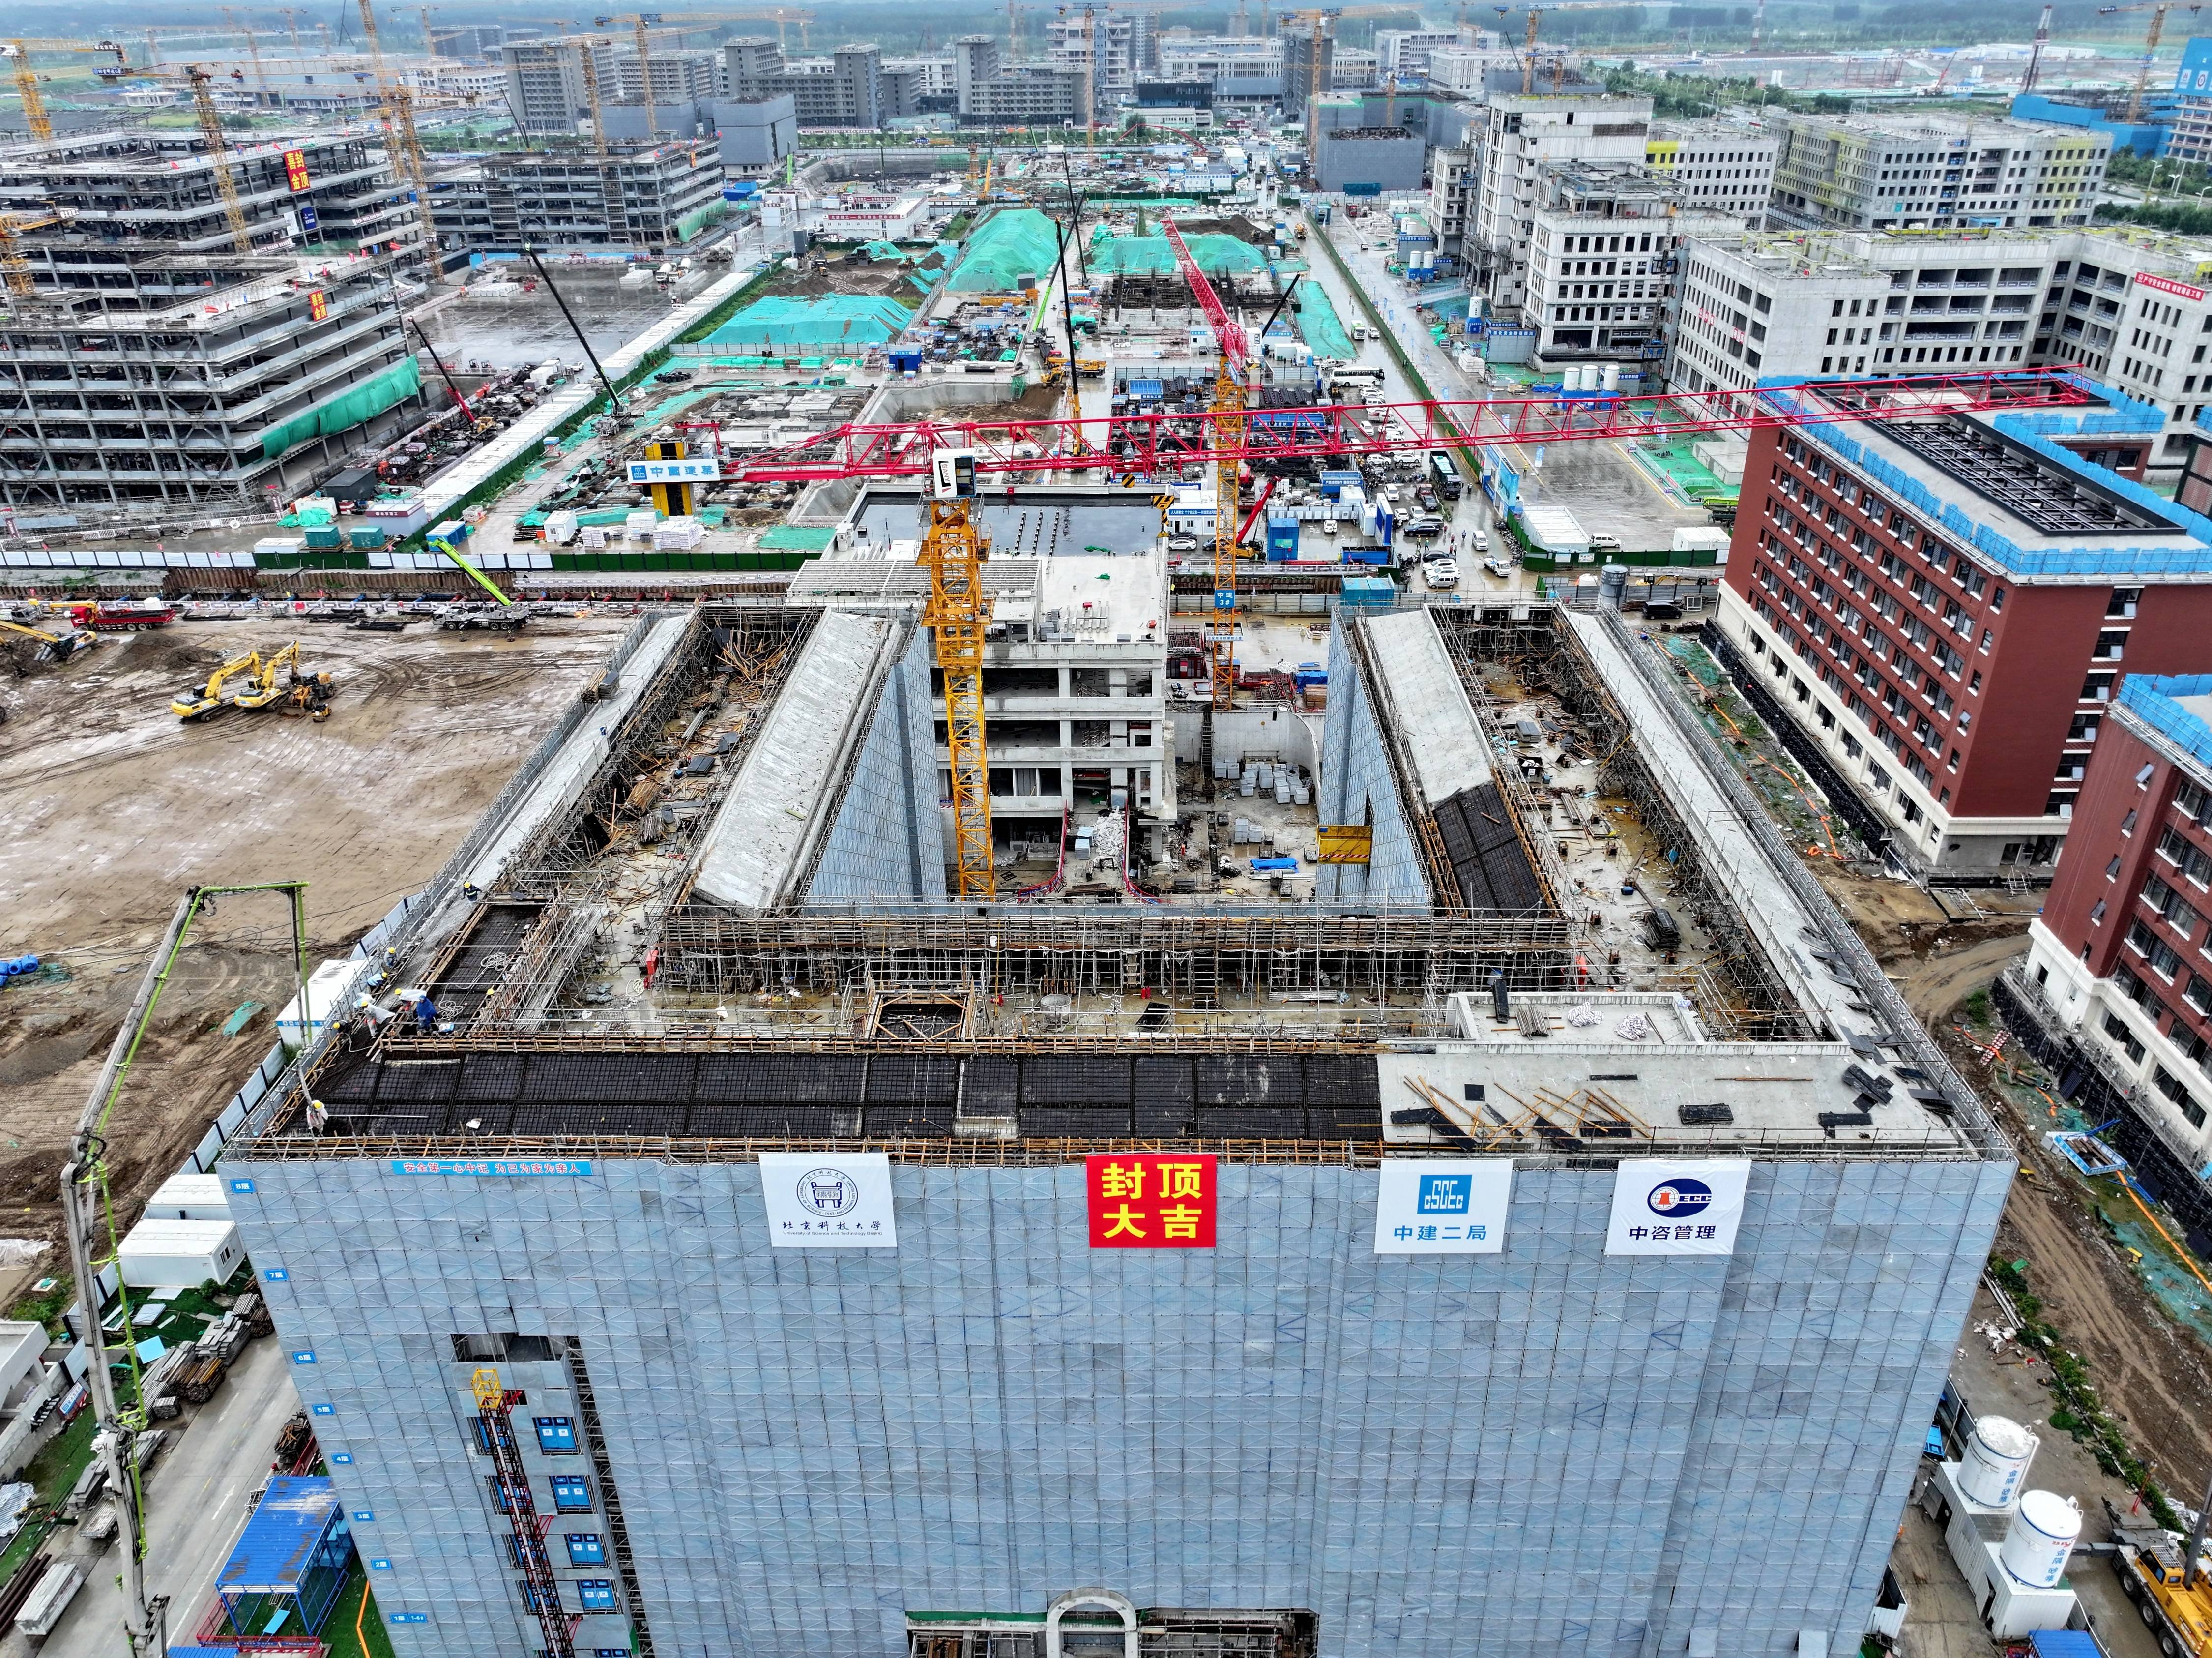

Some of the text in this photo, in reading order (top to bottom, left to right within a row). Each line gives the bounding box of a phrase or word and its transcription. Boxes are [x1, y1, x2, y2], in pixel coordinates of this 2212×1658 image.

[286, 151, 304, 170] 喜封
[291, 171, 310, 190] 金顶
[314, 305, 327, 320] 金顶
[941, 463, 950, 482] SANY
[404, 1163, 580, 1174] 安全第一心中记 为己为家为亲人
[1101, 1162, 1203, 1199] 封顶
[807, 1205, 822, 1214] SCIENCE
[783, 1221, 881, 1231] 北京科技大学
[1103, 1203, 1202, 1239] 大吉
[1394, 1225, 1487, 1241] 中建二局
[1629, 1226, 1717, 1241] 中咨管理
[2052, 1549, 2066, 1564] 金隅
